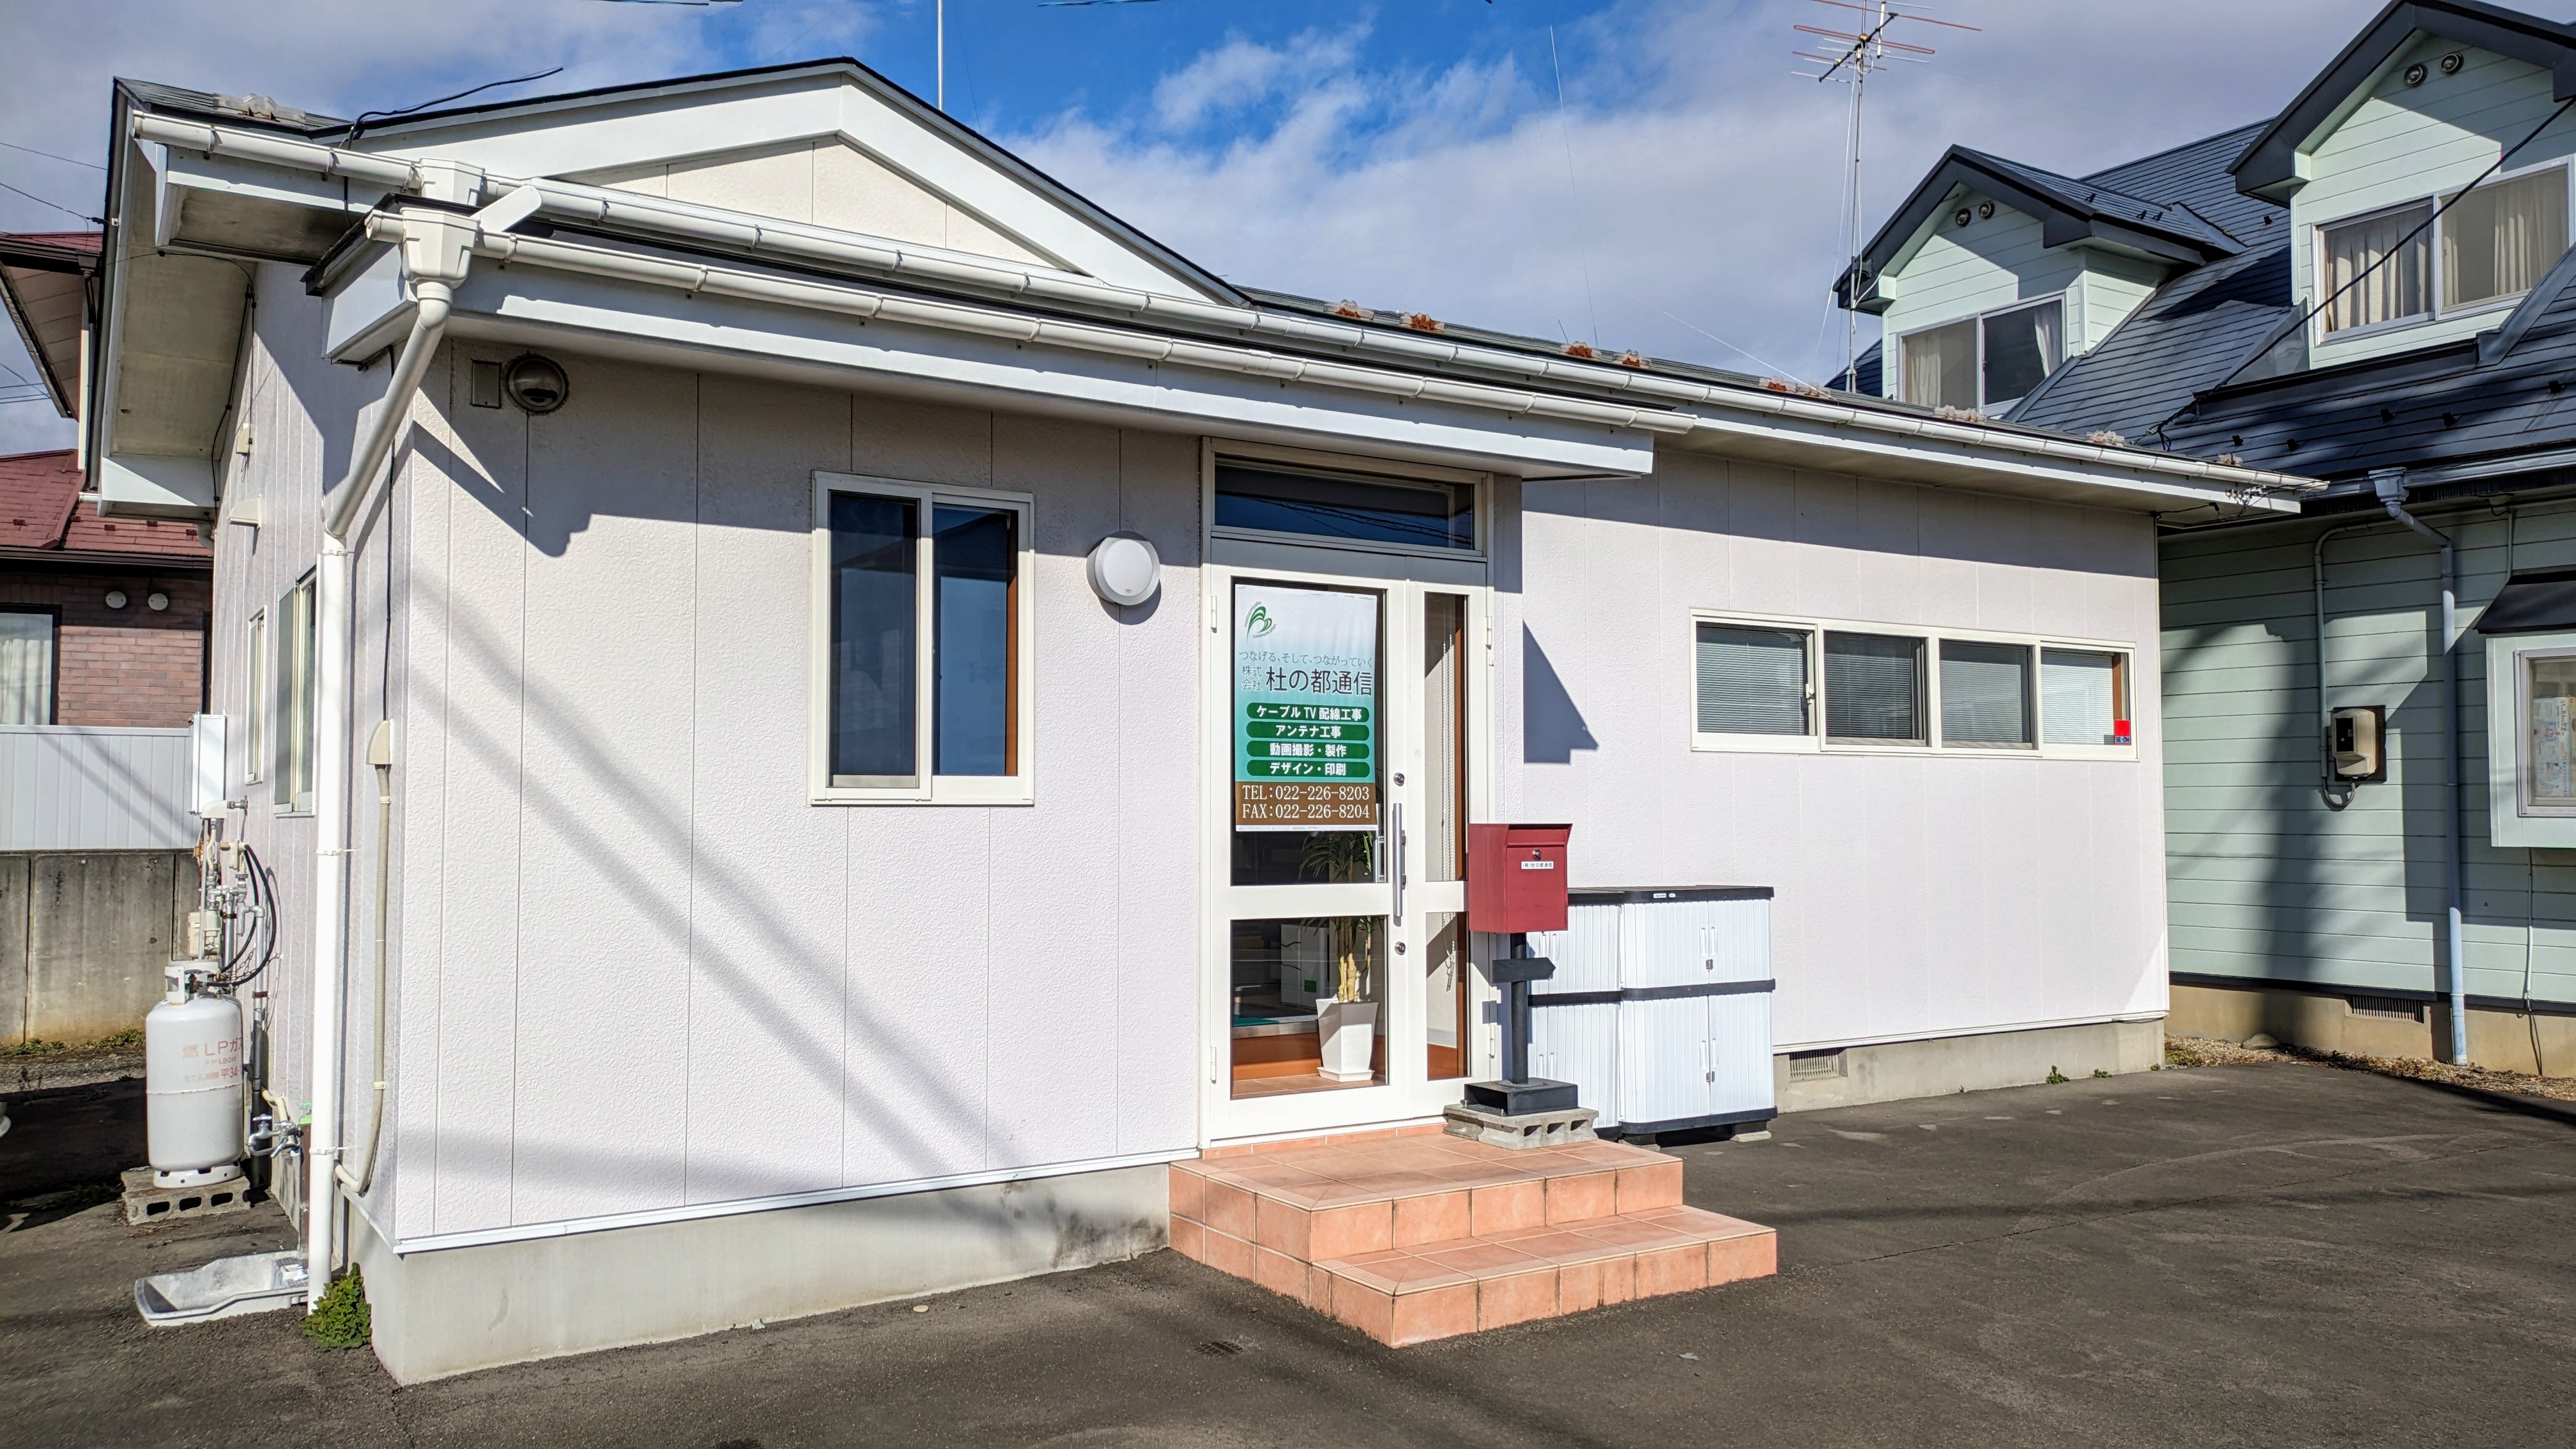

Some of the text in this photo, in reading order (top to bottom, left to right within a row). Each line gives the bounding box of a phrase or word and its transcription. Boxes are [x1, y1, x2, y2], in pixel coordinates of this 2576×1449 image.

[1244, 601, 1262, 627] morinomiyako
[1252, 623, 1277, 638] communication
[1239, 650, 1372, 668] つなげる、そして、つながっていく
[1241, 665, 1262, 677] 株式
[1241, 678, 1262, 691] 会社
[1266, 666, 1372, 696] 杜の都通信
[1275, 724, 1342, 739] アンテナ工事
[1269, 742, 1347, 758] 動画撮影・製作
[1269, 762, 1347, 776] デザイン・印刷
